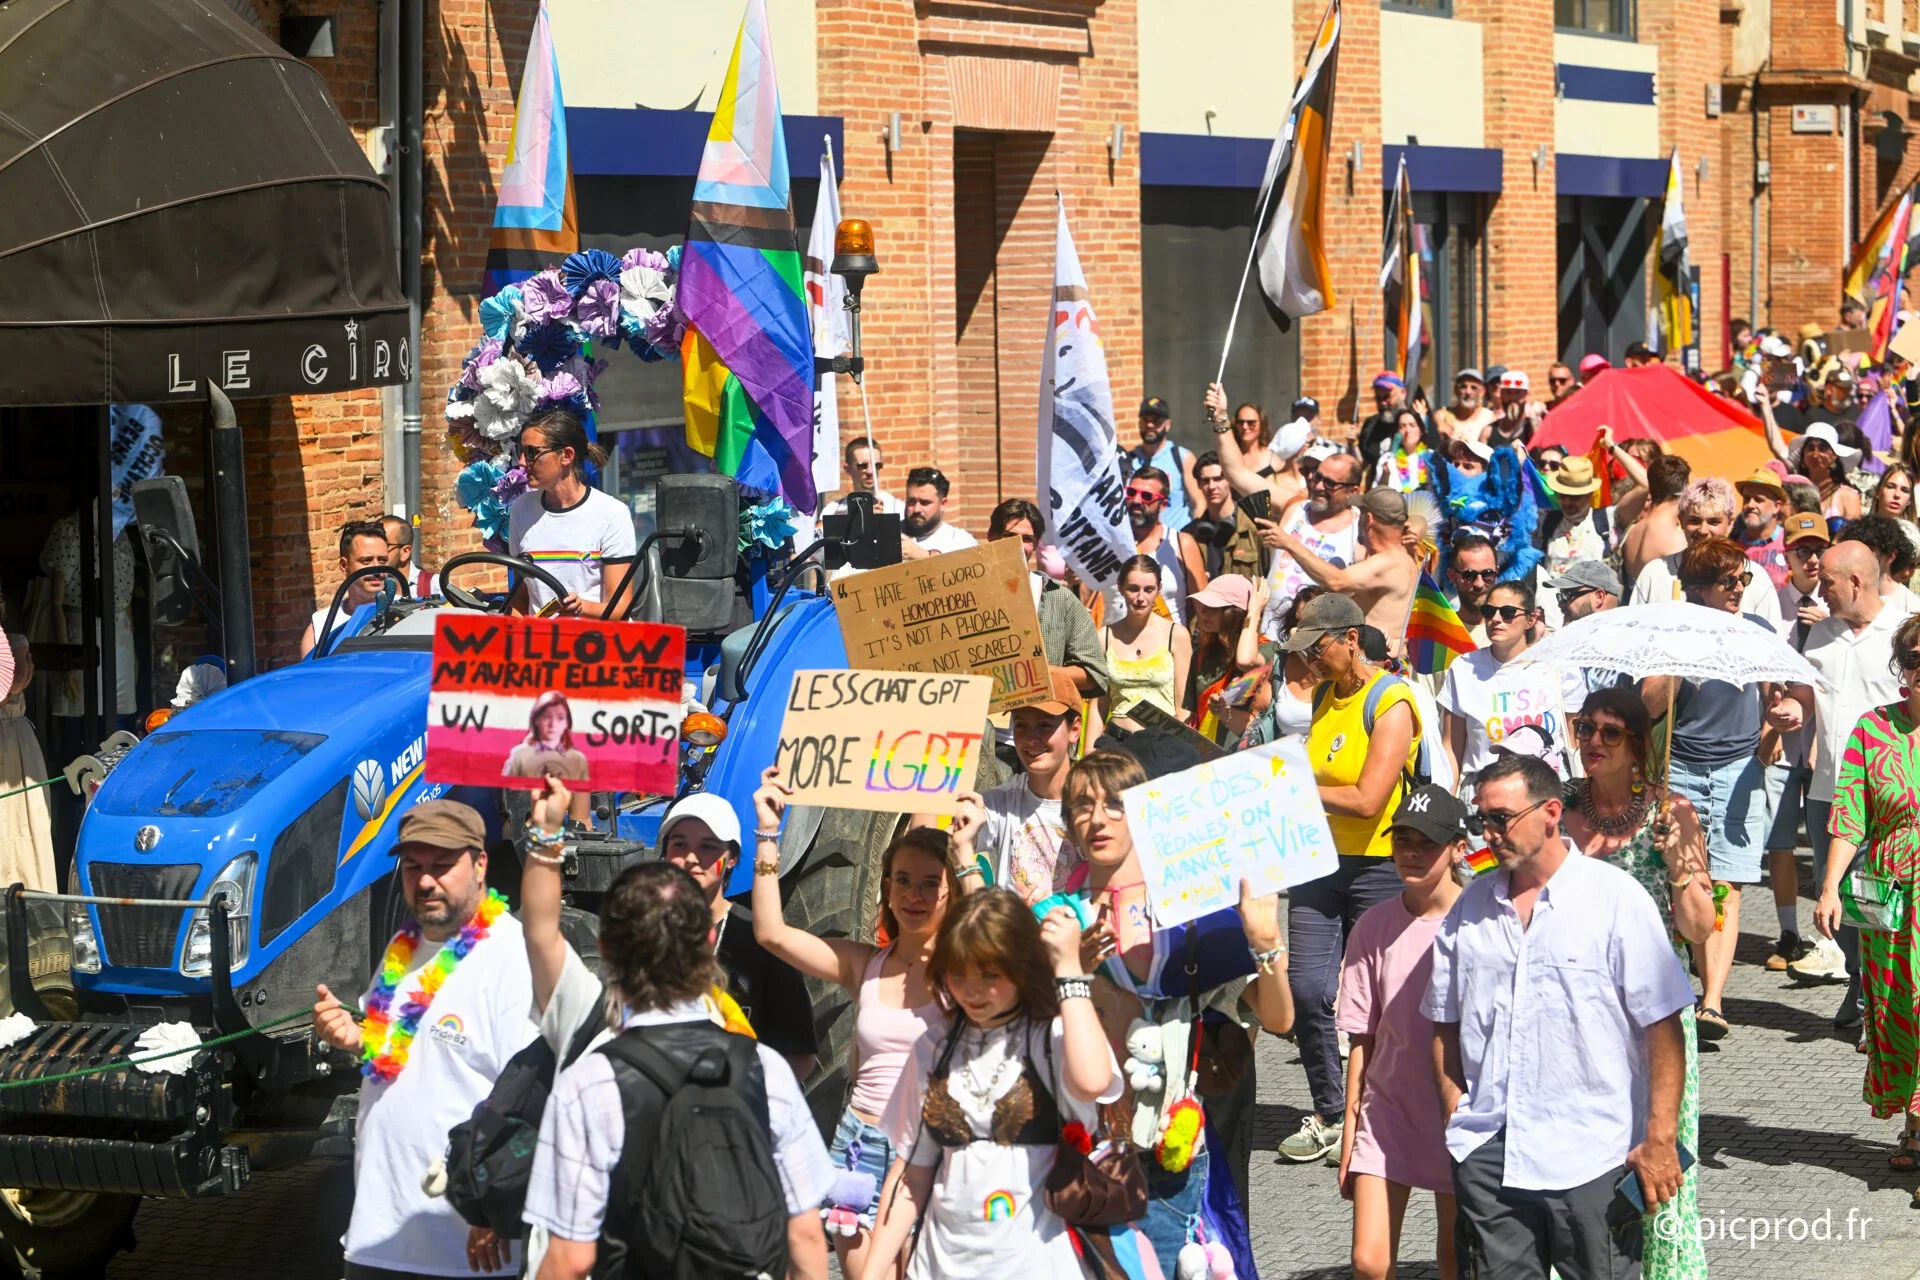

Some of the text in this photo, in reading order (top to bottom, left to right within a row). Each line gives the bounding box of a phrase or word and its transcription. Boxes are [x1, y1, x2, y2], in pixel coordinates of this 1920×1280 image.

[168, 350, 250, 393] LE
[874, 582, 907, 609] HATE
[913, 574, 938, 596] THE
[942, 563, 985, 588] WORD
[864, 635, 902, 660] IT'S
[906, 630, 933, 648] NOT
[940, 623, 952, 641] A
[565, 663, 619, 689] ELLE
[932, 650, 963, 674] NOT
[919, 678, 970, 705] GPT
[1492, 688, 1550, 713] IT'S A
[442, 704, 677, 764] UN SORT?
[391, 735, 423, 786] NEW
[774, 729, 983, 793] MORE LGBT
[1147, 773, 1260, 829] AVEC DES
[1241, 800, 1271, 826] ON
